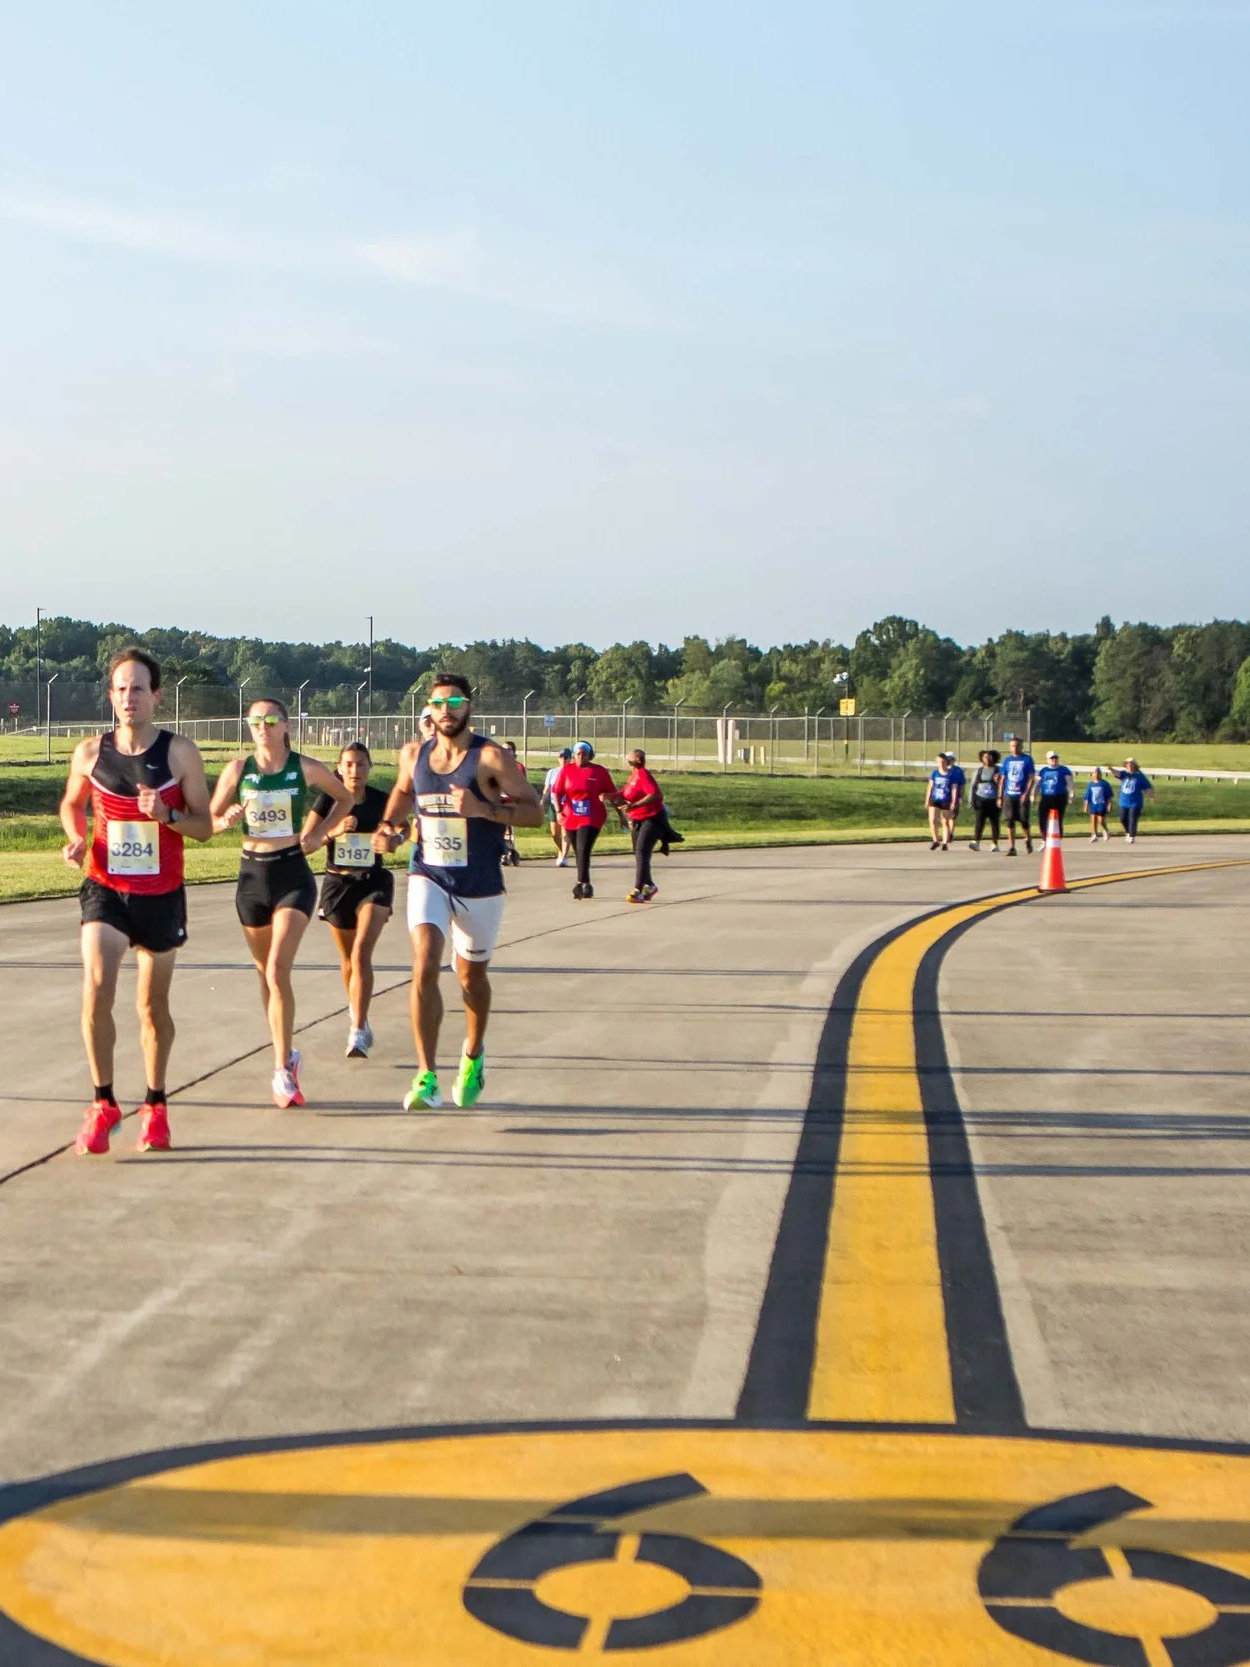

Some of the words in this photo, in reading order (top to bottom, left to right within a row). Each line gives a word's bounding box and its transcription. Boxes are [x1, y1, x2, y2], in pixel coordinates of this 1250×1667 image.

[250, 809, 287, 823] 3493
[112, 842, 154, 857] 3284
[338, 847, 370, 860] 3187
